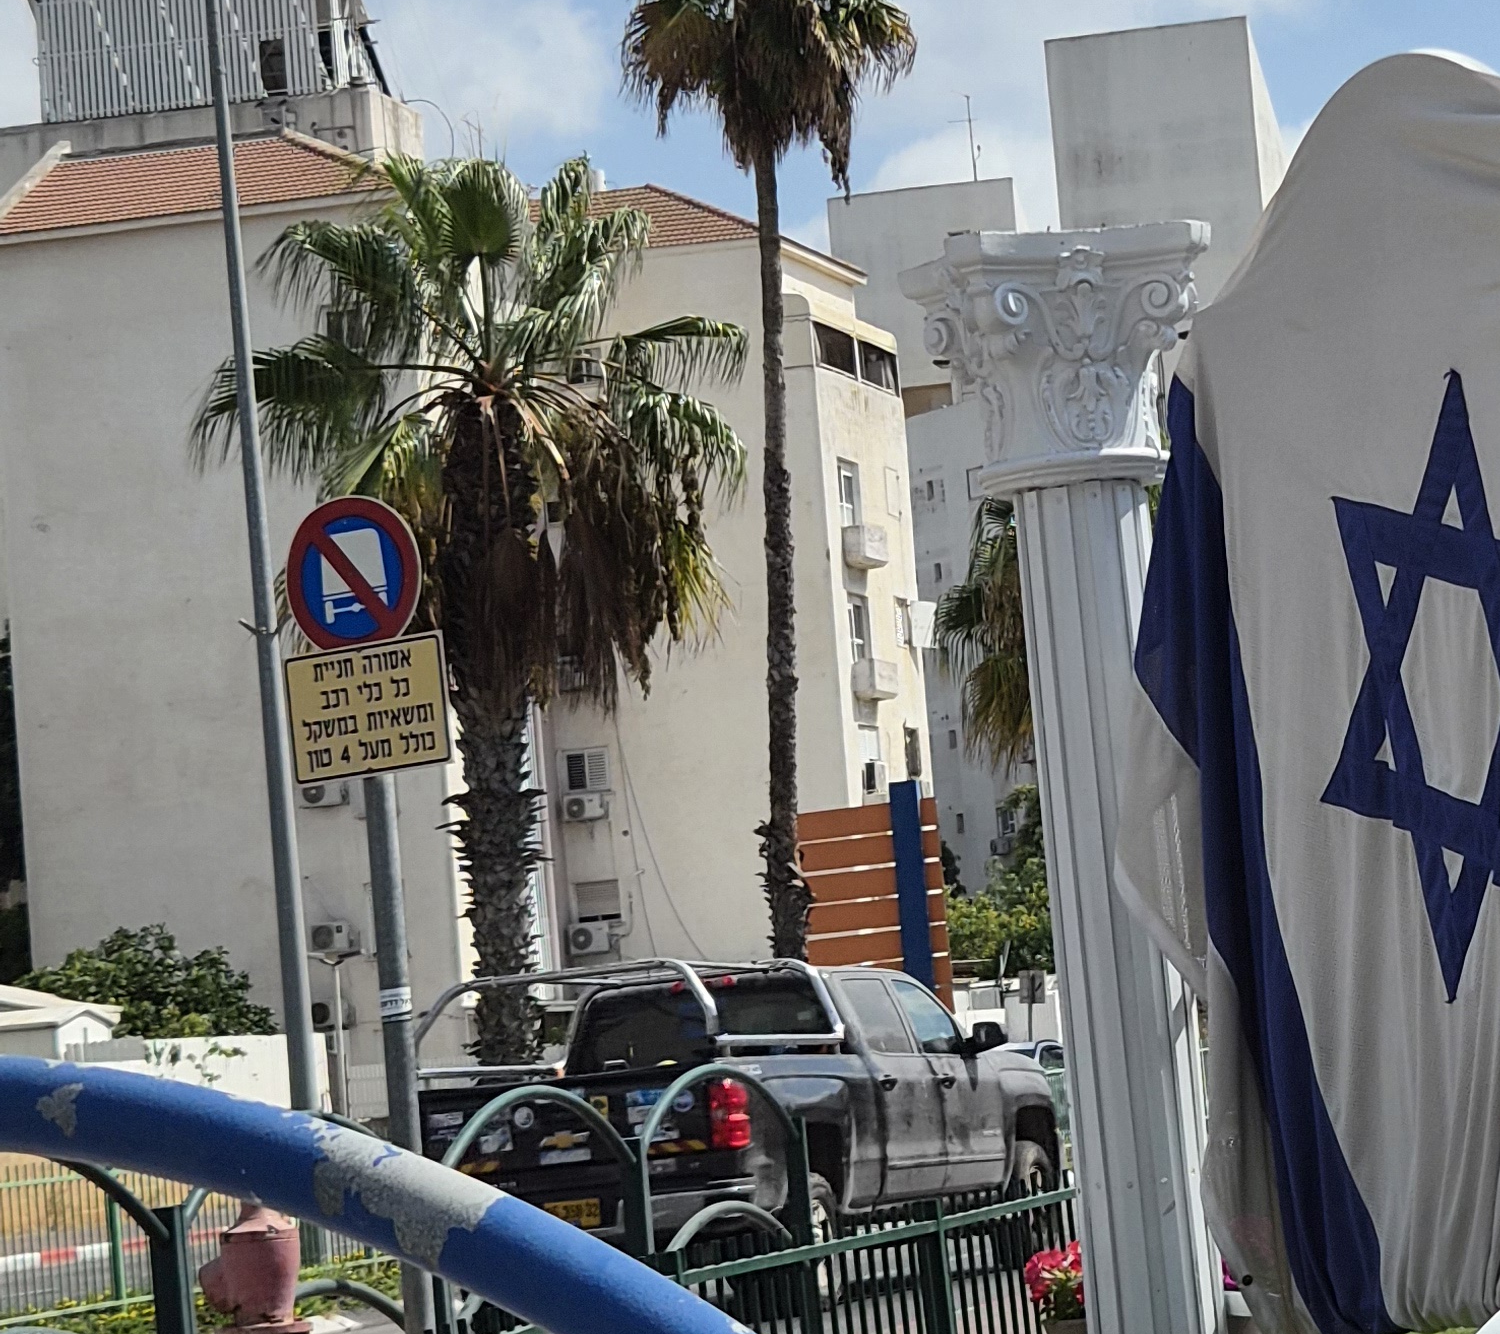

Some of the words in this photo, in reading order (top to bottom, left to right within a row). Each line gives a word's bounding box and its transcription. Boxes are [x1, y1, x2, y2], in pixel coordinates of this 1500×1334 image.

[313, 657, 354, 683] חניית
[362, 648, 412, 674] אסורה
[320, 687, 349, 710] רכב
[356, 681, 383, 703] כלי
[390, 675, 410, 698] כל
[302, 714, 359, 743] במשקל
[366, 702, 435, 731] ומשאיות
[340, 744, 351, 764] 4
[358, 737, 392, 761] מעל
[399, 730, 437, 755] כולל
[306, 747, 333, 772] טון
